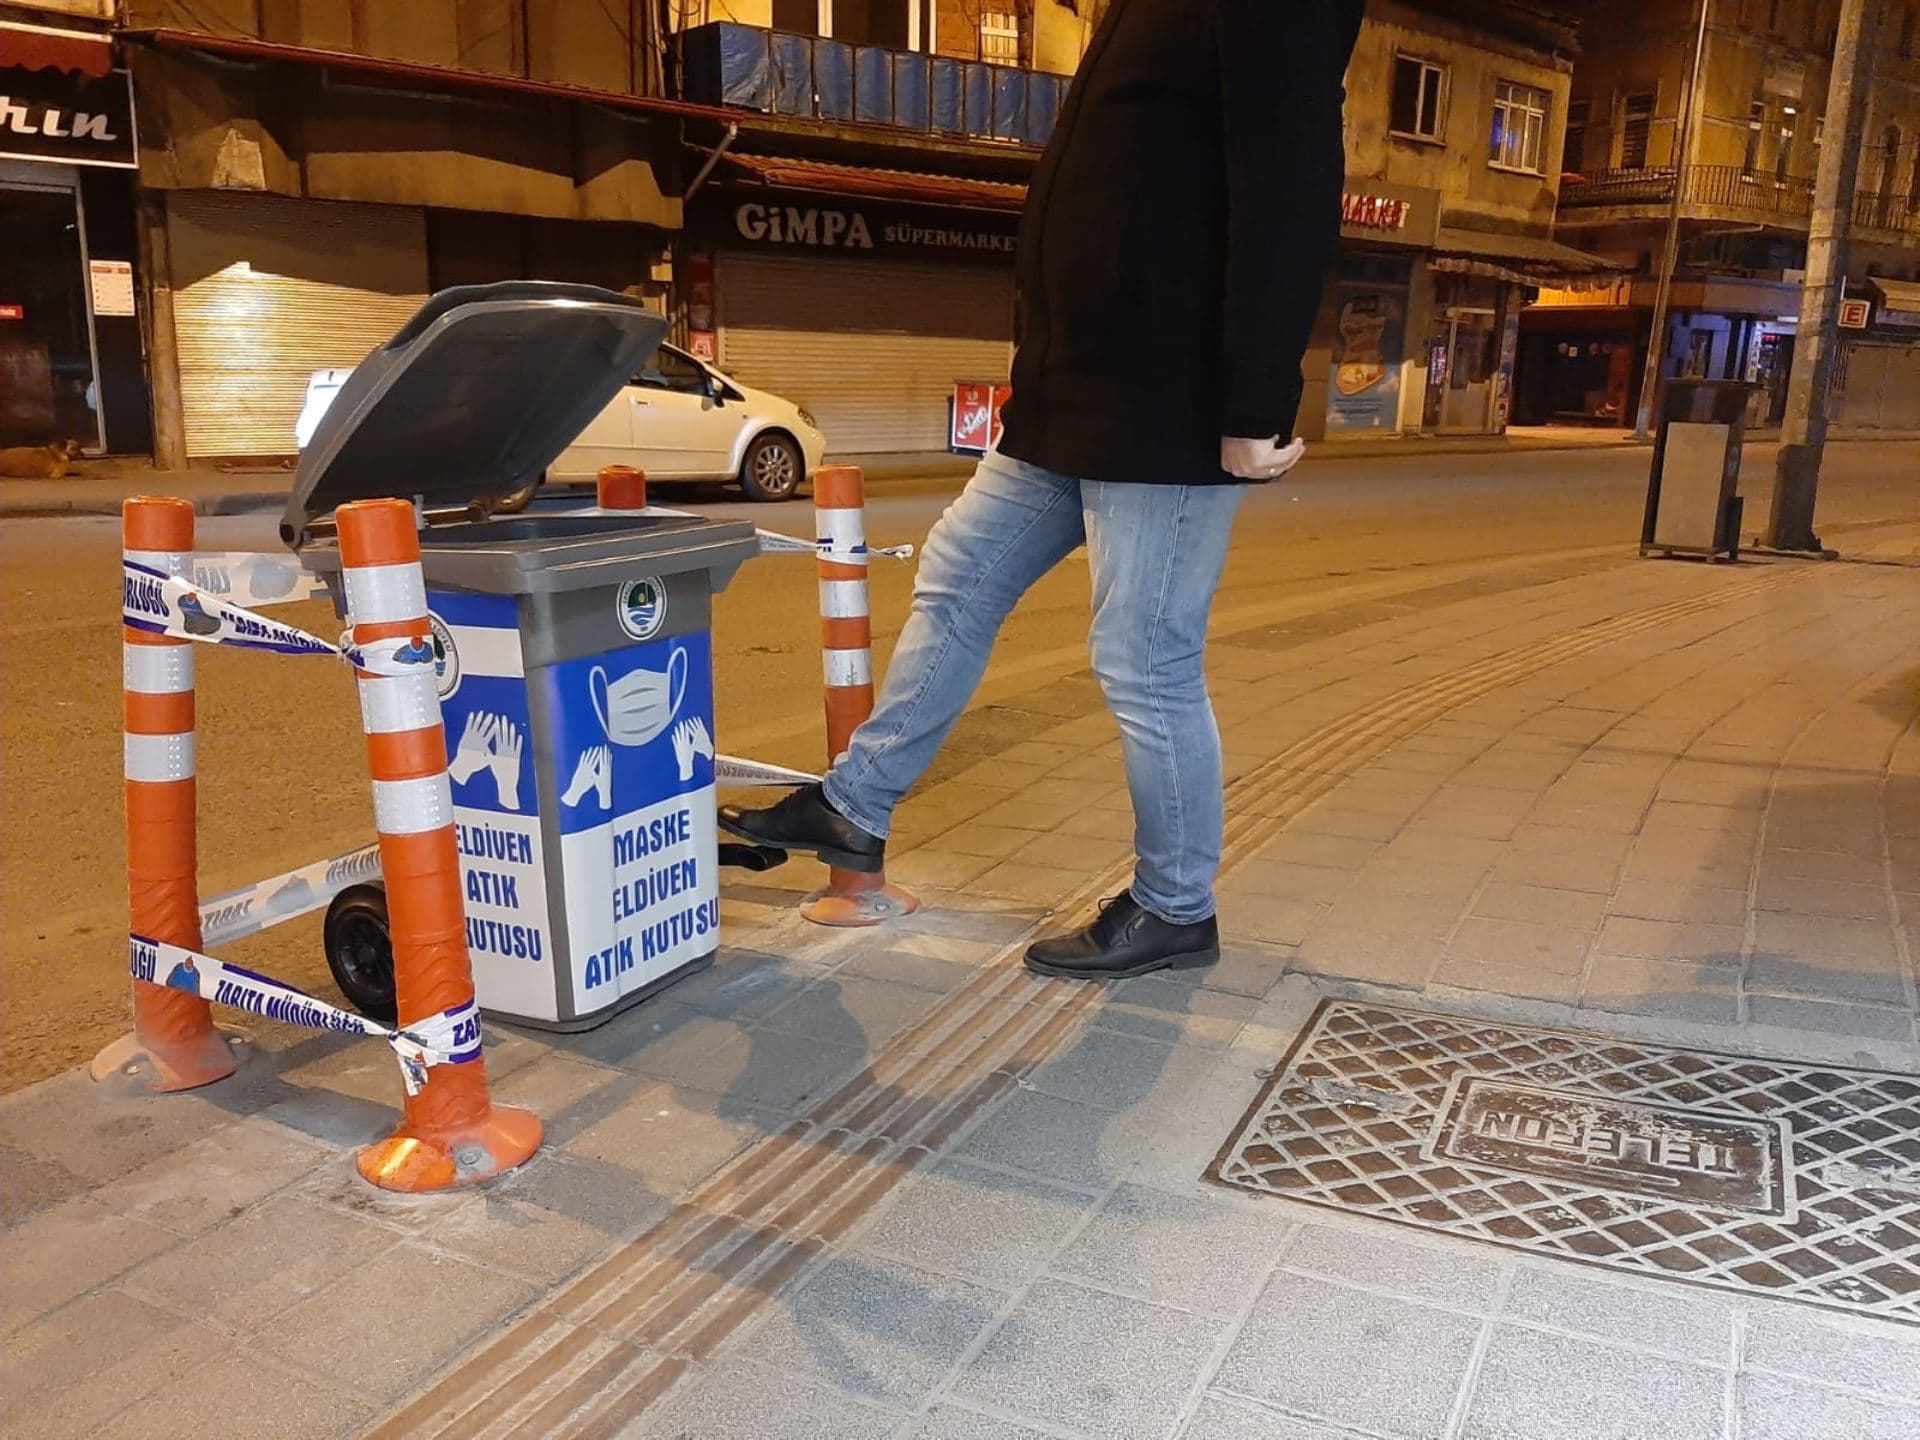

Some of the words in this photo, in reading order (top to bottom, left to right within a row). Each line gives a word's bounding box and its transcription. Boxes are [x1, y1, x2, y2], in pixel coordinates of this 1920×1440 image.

[885, 223, 1018, 252] SÜPERMARKE
[124, 574, 170, 617] RLÜĞÜ
[613, 809, 690, 868] MASKE
[466, 869, 519, 909] ATIK
[613, 858, 697, 923] ELDİVEN
[585, 936, 634, 990] ATIK
[642, 896, 719, 961] KUTUSU
[1481, 1110, 1738, 1175] TELEFON
